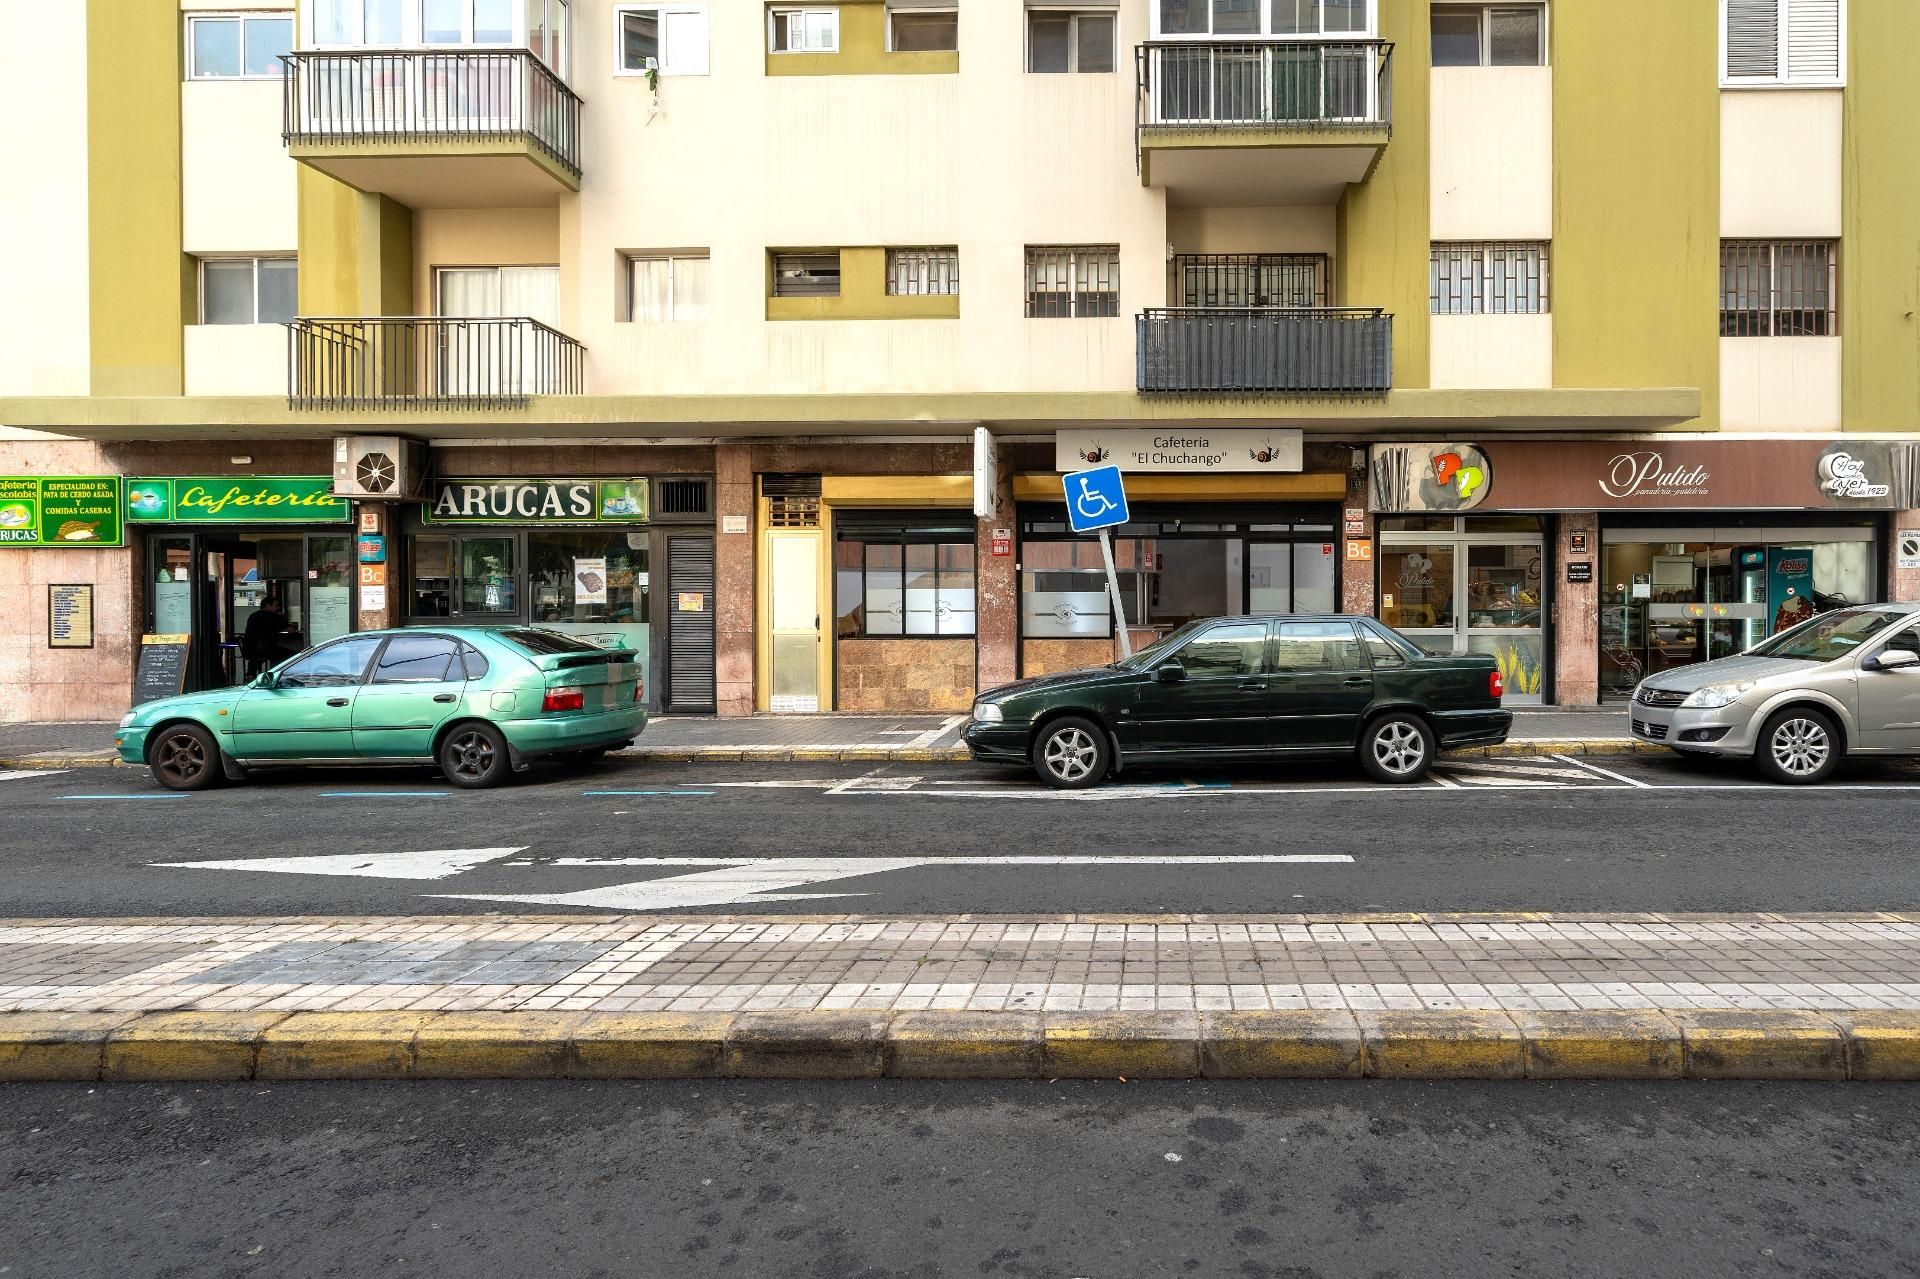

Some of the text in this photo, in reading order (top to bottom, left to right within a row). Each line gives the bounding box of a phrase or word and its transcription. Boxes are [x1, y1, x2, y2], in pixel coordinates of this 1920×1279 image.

[1153, 436, 1209, 448] Cafeteria
[1132, 452, 1227, 466] "El Chuchango"
[1598, 451, 1710, 498] Pulido
[0, 481, 37, 490] afeteria
[48, 483, 96, 491] ESPECIALIDAD
[1832, 479, 1867, 495] ayer
[1867, 487, 1887, 495] 1923
[0, 490, 37, 499] scolabis
[433, 485, 592, 517] ARUCAS
[75, 499, 82, 507] Y
[45, 507, 78, 515] COMIDAS
[0, 530, 38, 541] RUCAS
[1347, 542, 1371, 558] Bc
[1780, 559, 1808, 573] Kalise
[361, 567, 383, 583] Bc
[1394, 573, 1435, 588] Pulido
